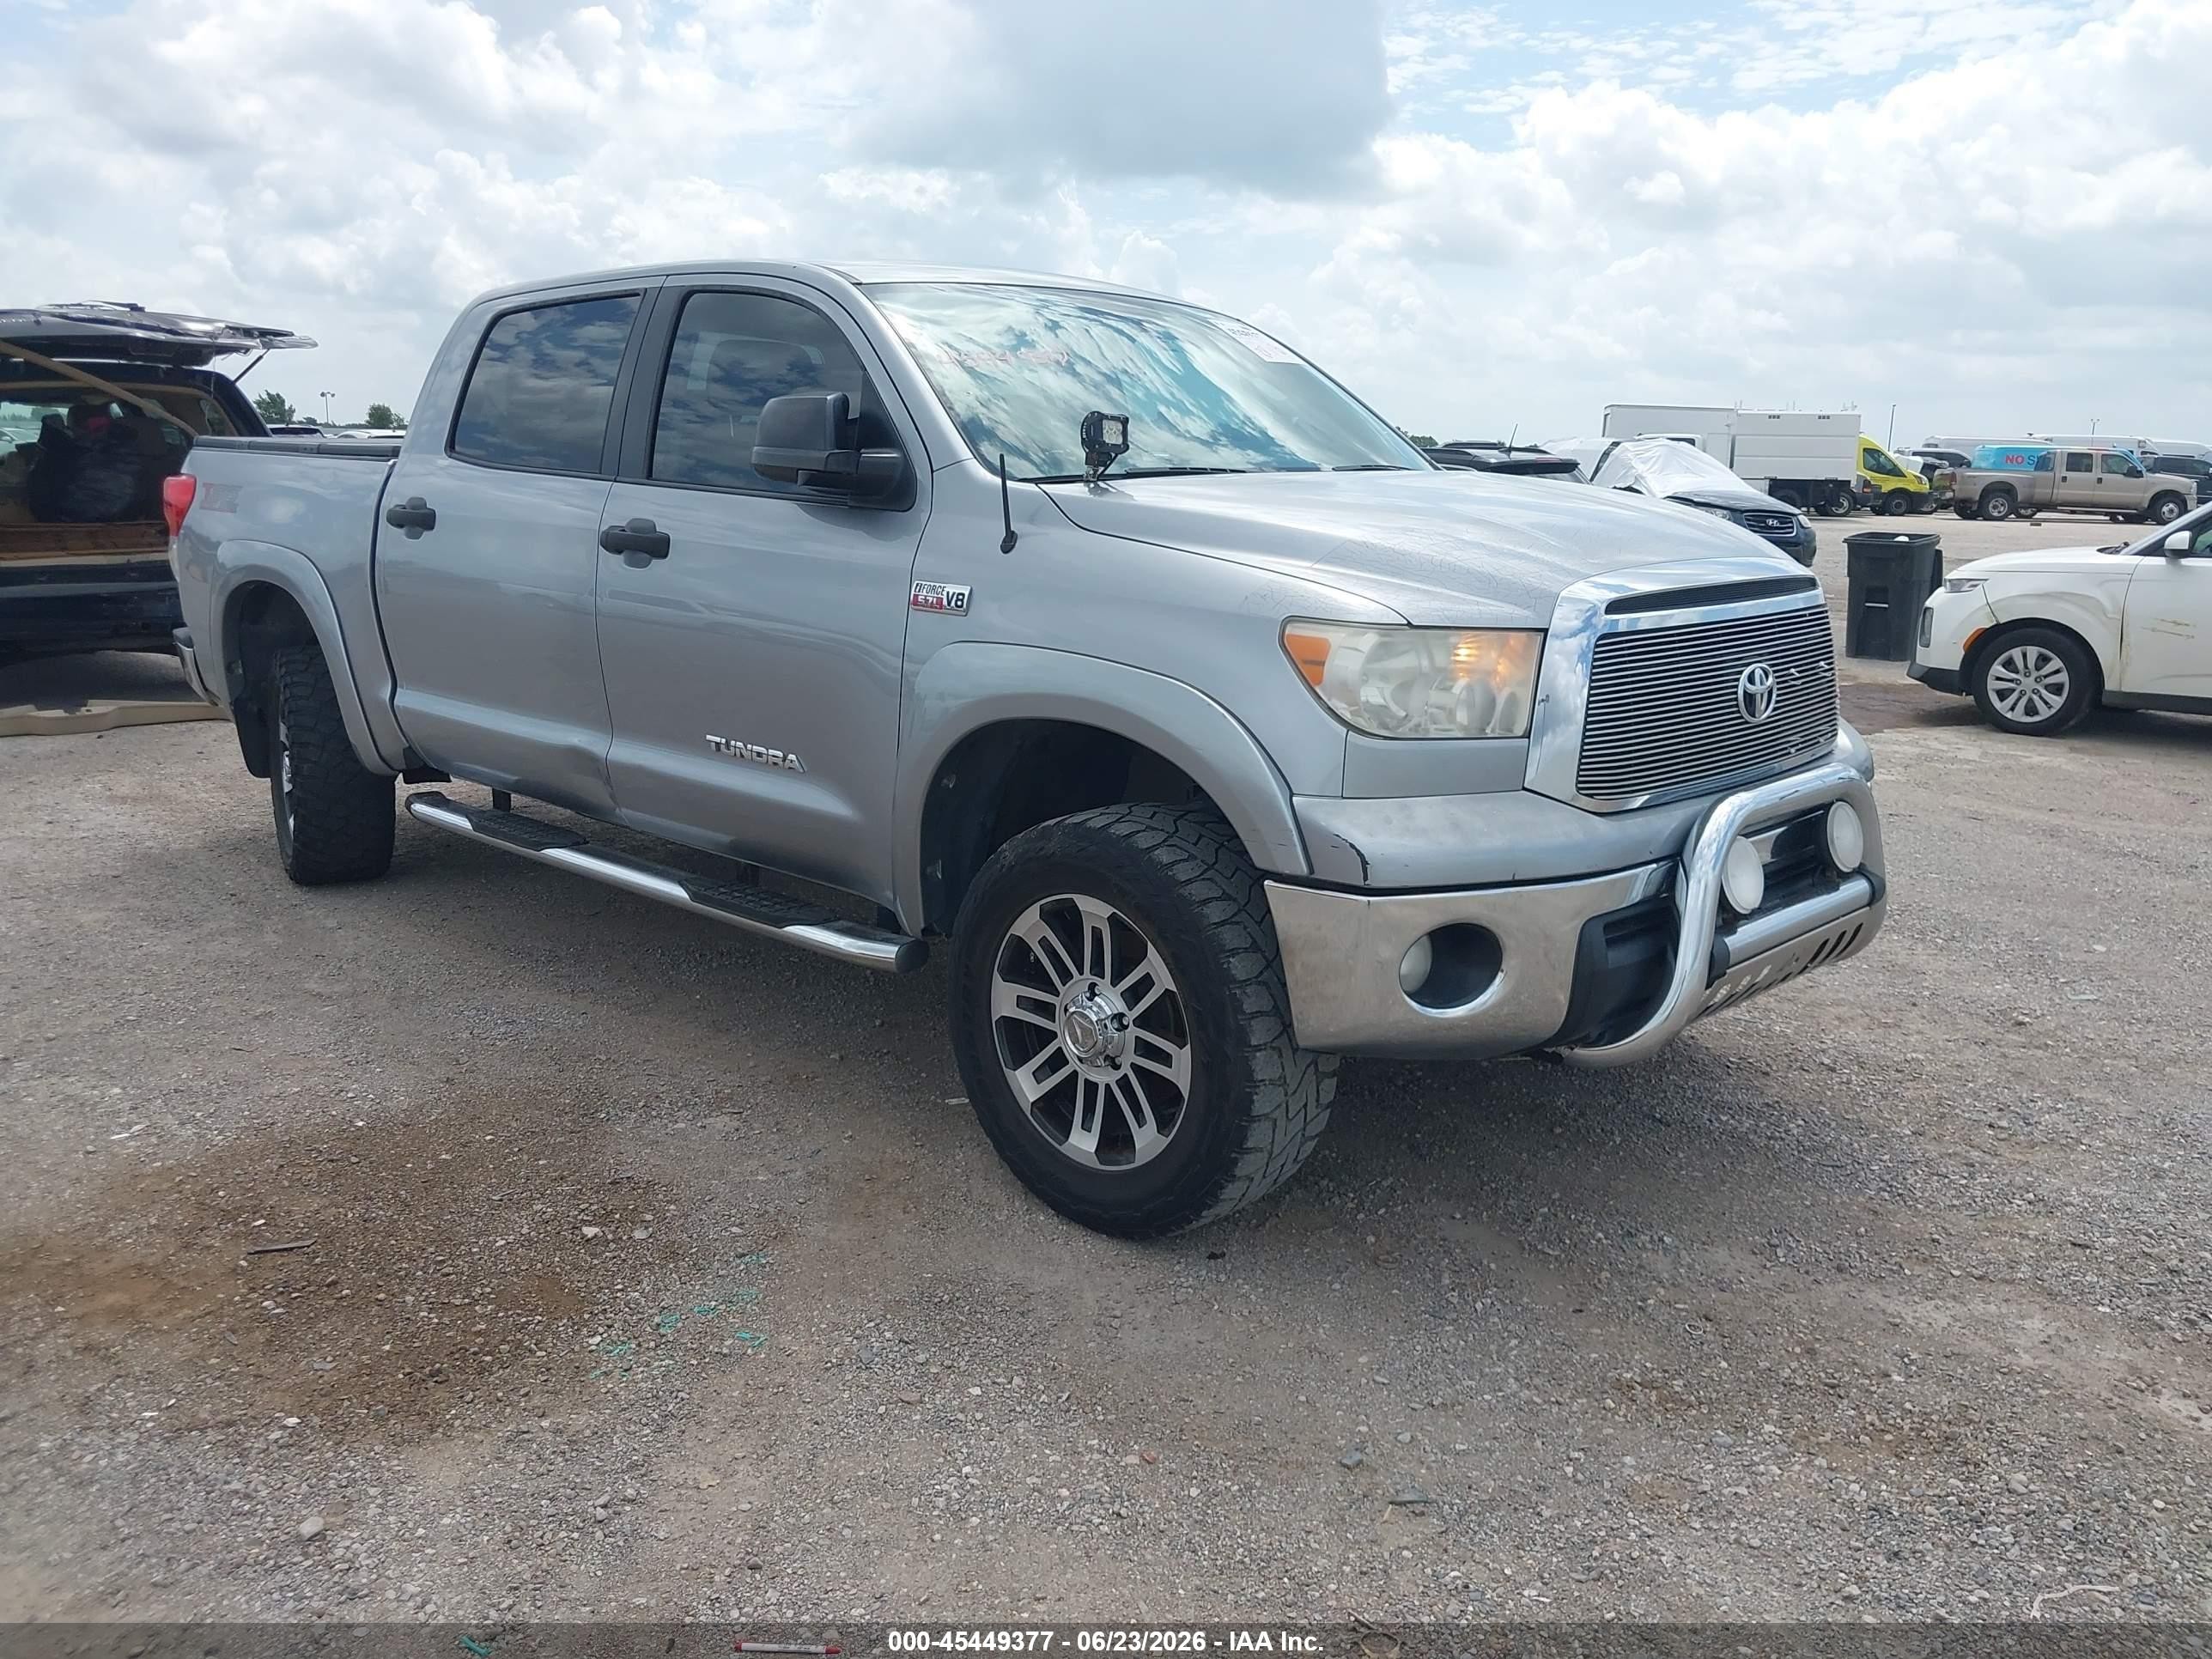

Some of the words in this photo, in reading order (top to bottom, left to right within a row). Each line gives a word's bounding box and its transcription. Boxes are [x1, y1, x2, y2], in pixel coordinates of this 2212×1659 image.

[2005, 454, 2025, 465] NO
[946, 590, 966, 609] V8
[705, 733, 805, 774] TUNDRA
